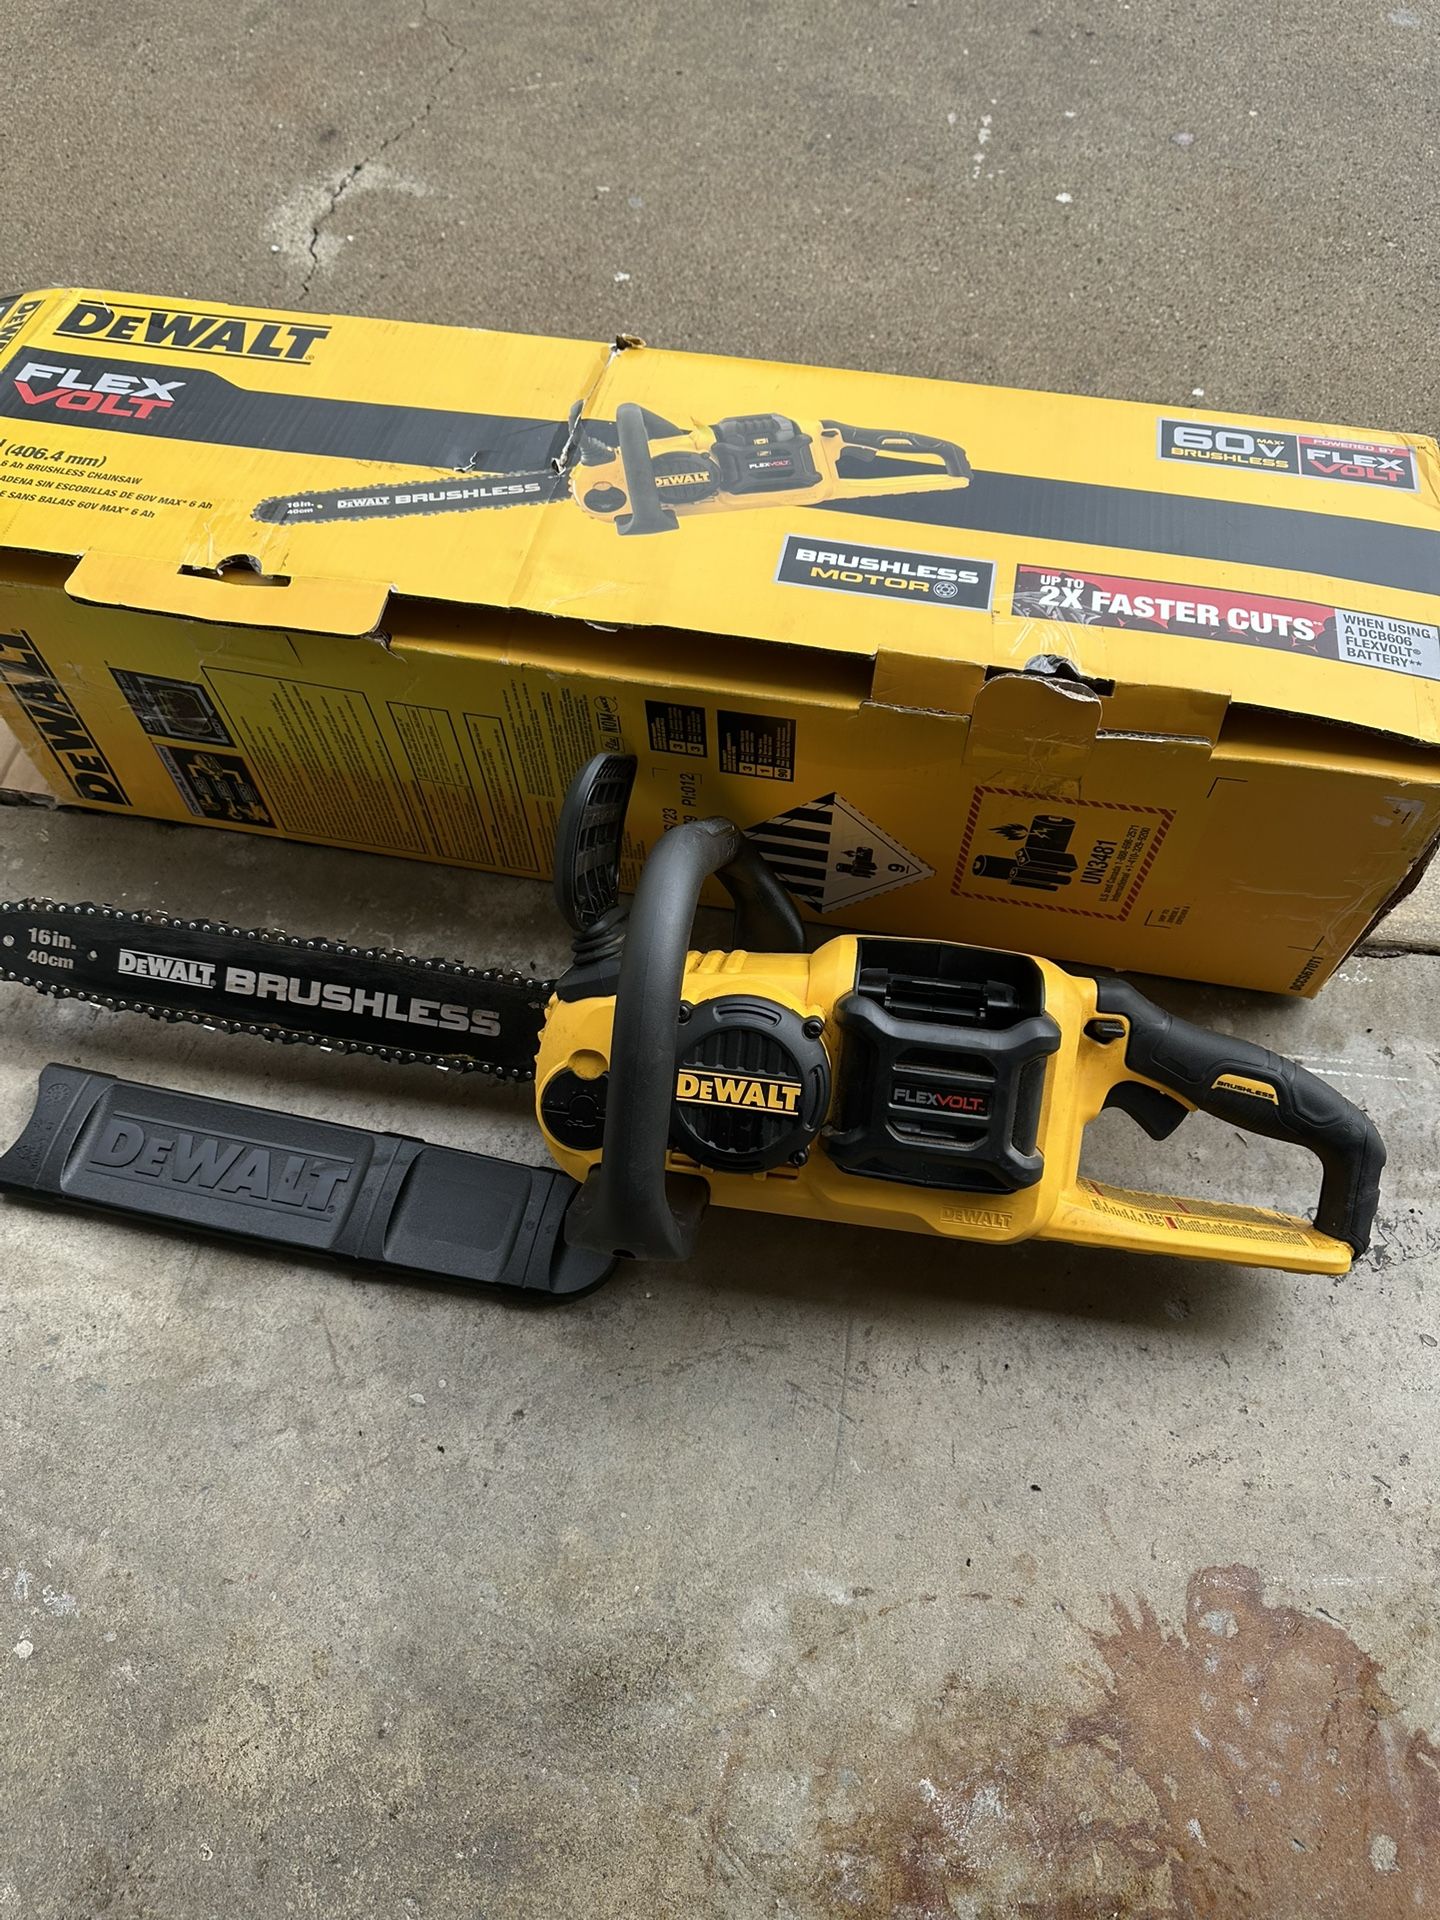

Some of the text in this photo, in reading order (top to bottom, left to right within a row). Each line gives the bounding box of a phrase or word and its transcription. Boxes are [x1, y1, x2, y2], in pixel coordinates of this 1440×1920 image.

[57, 303, 328, 360] DEWALT
[14, 362, 185, 401] FLEX
[14, 381, 174, 420] VOLT
[5, 444, 107, 468] (406.4 mm)
[1313, 438, 1375, 452] POWERED
[1171, 447, 1289, 469] BRUSHLESS
[1307, 448, 1404, 471] FLEX
[9, 461, 24, 469] Ah
[26, 463, 86, 478] BRUSHLESS
[87, 471, 143, 485] CHAINSAW
[655, 472, 711, 487] DEWALT
[1310, 460, 1405, 482] VOLT
[8, 491, 36, 501] SANS
[38, 495, 75, 507] BALAIS
[77, 500, 99, 510] 60V
[131, 508, 138, 516] 6
[139, 510, 156, 519] Ah
[35, 480, 54, 488] SIN
[55, 483, 117, 498] ESCOBILLAS
[119, 491, 133, 499] DE
[135, 493, 157, 502] 60V
[189, 500, 197, 508] 6
[198, 502, 213, 510] Ah
[337, 483, 541, 509] DEWALT BRUSHLESS
[796, 548, 979, 584] BRUSHLESS
[810, 567, 930, 592] MOTOR
[1040, 574, 1085, 590] UP TO
[1039, 586, 1085, 610] 2X
[1091, 590, 1220, 628] FASTER
[1343, 614, 1431, 639] WHEN USING
[1345, 625, 1413, 646] A DCB606
[690, 744, 700, 752] 3
[777, 767, 788, 779] 90
[1081, 840, 1117, 884] UN3481
[27, 949, 75, 971] 40cm
[118, 949, 500, 1037] DEWALT BRUSHLESS
[676, 1073, 802, 1112] DEWALT
[893, 1088, 985, 1113] FLEXVOLT
[1217, 1080, 1275, 1099] BRUSHLESS
[90, 1119, 351, 1212] DEWALT
[942, 1206, 1012, 1228] DEWALT
